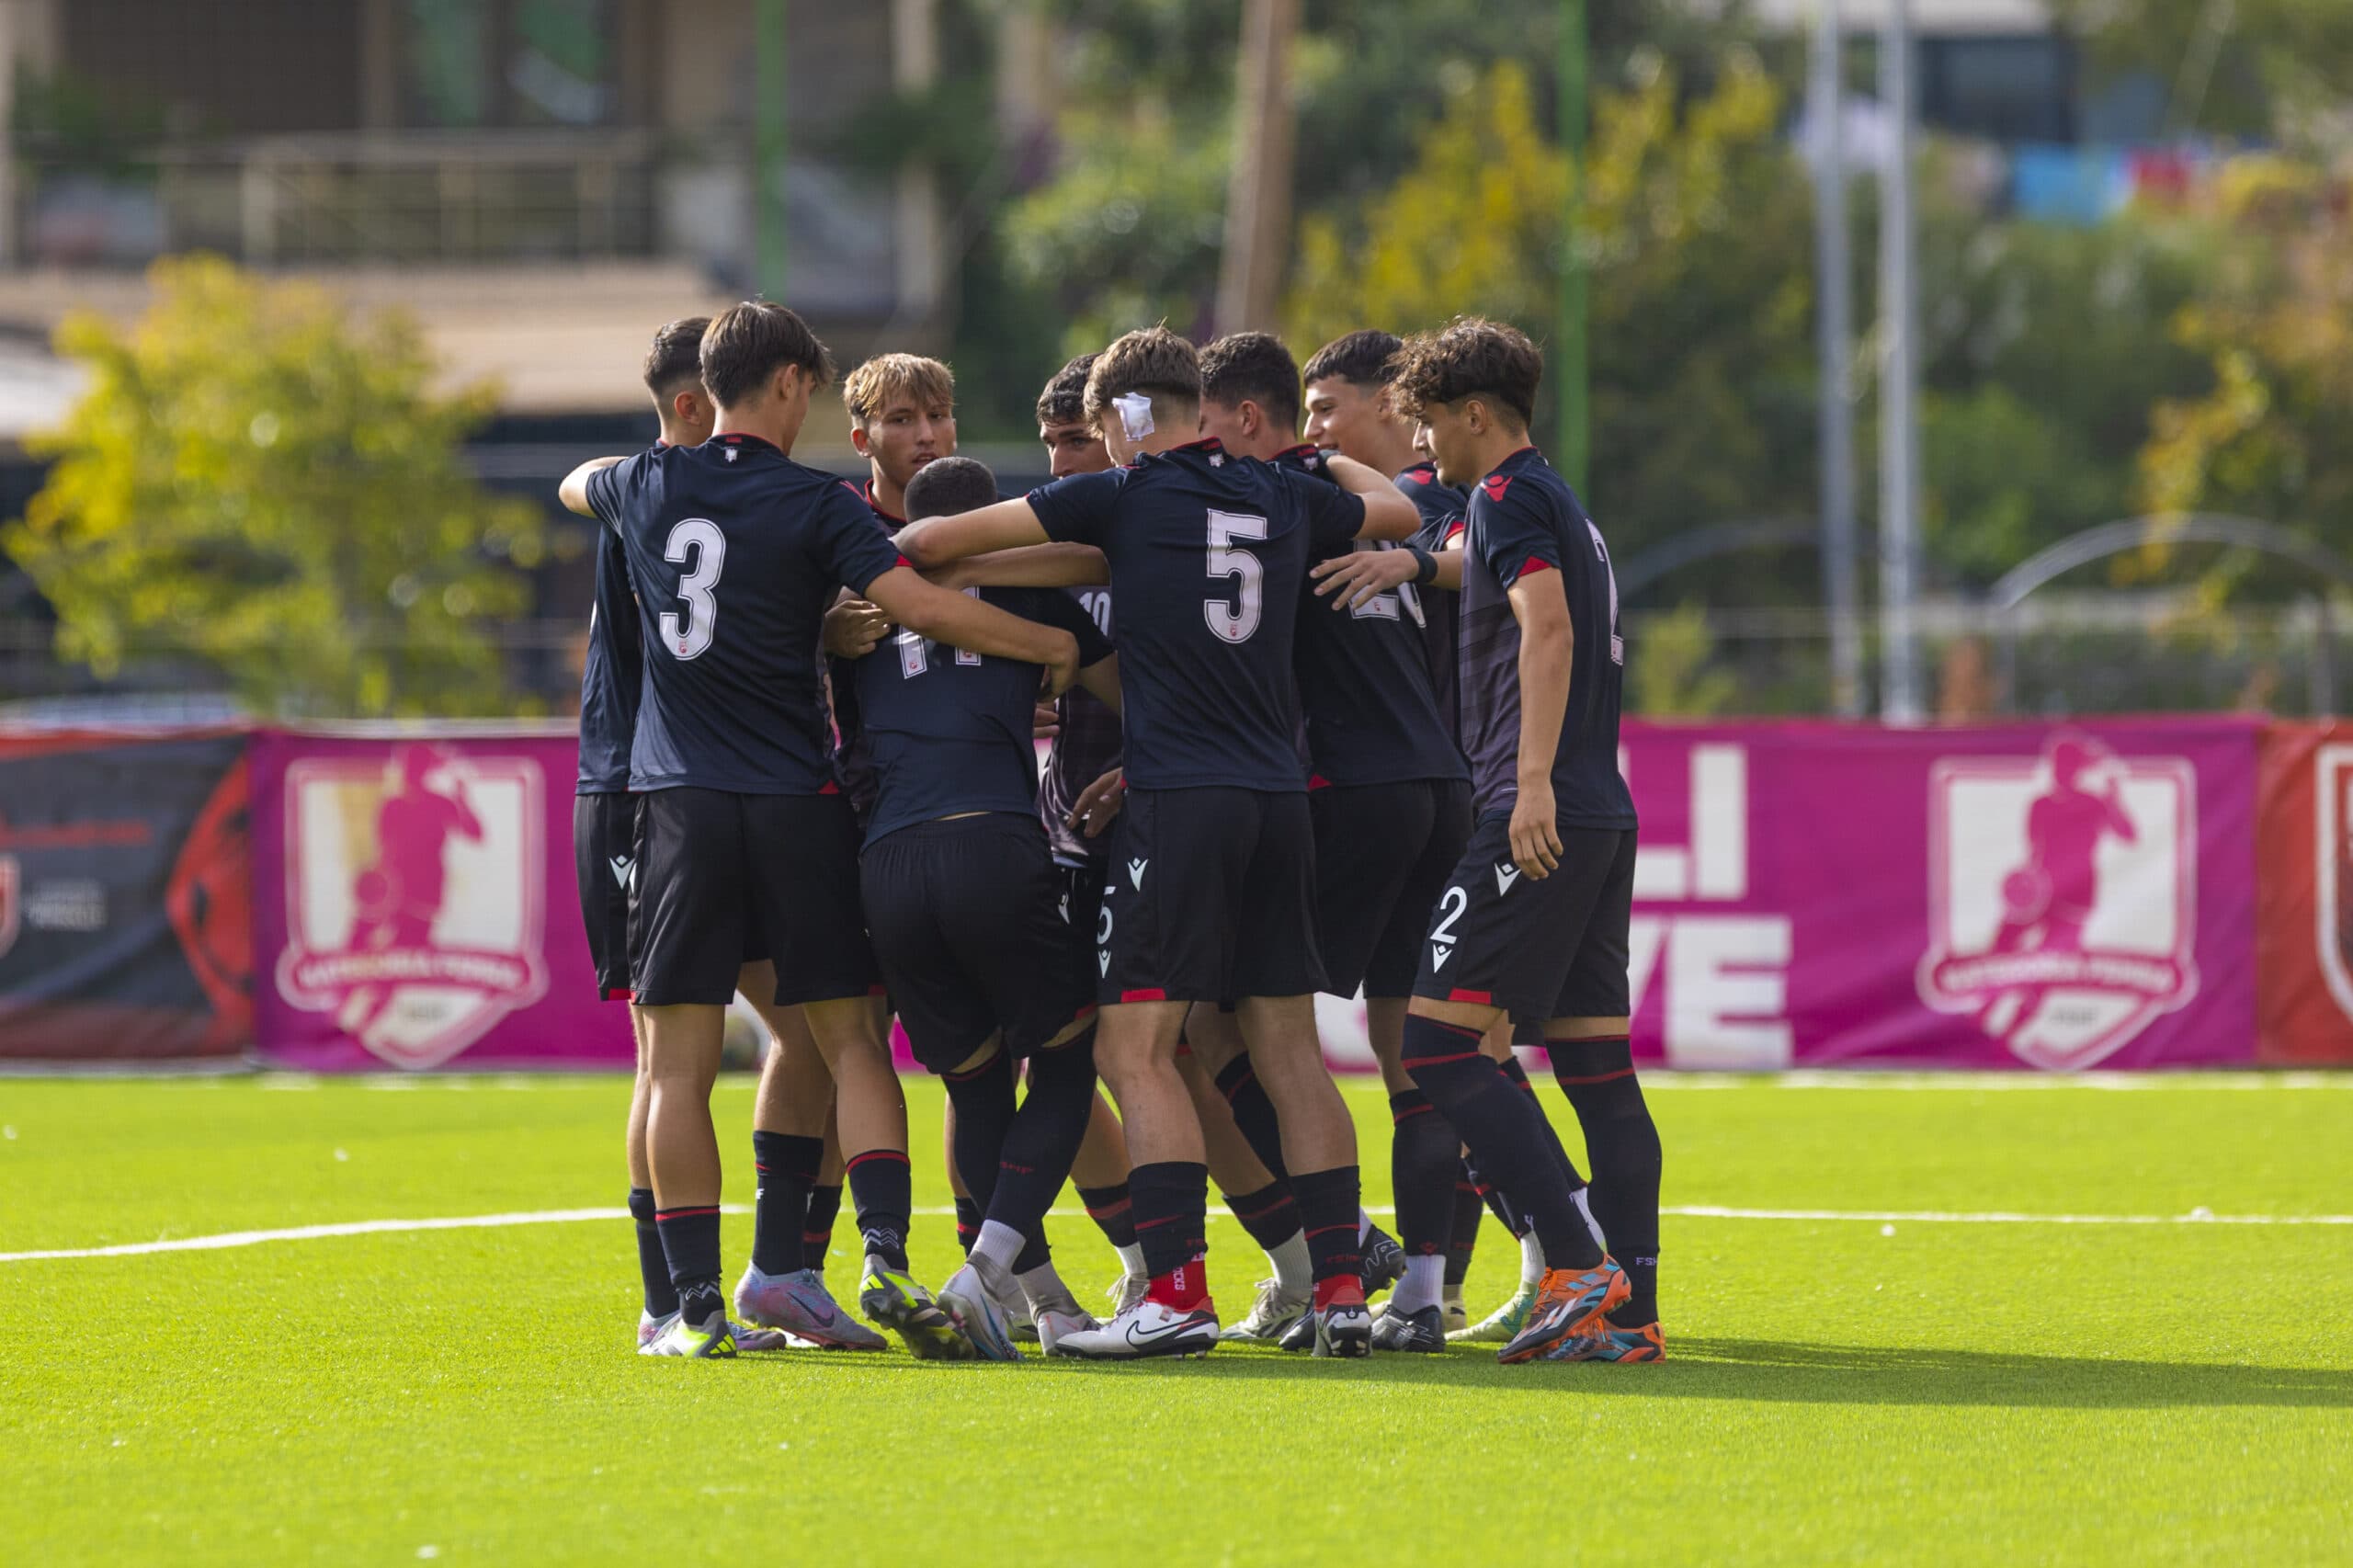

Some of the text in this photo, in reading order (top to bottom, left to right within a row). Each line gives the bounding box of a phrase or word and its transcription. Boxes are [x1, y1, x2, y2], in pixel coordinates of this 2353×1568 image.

[658, 517, 726, 661] 3
[1204, 508, 1267, 643] 5
[1429, 886, 1468, 945] 2
